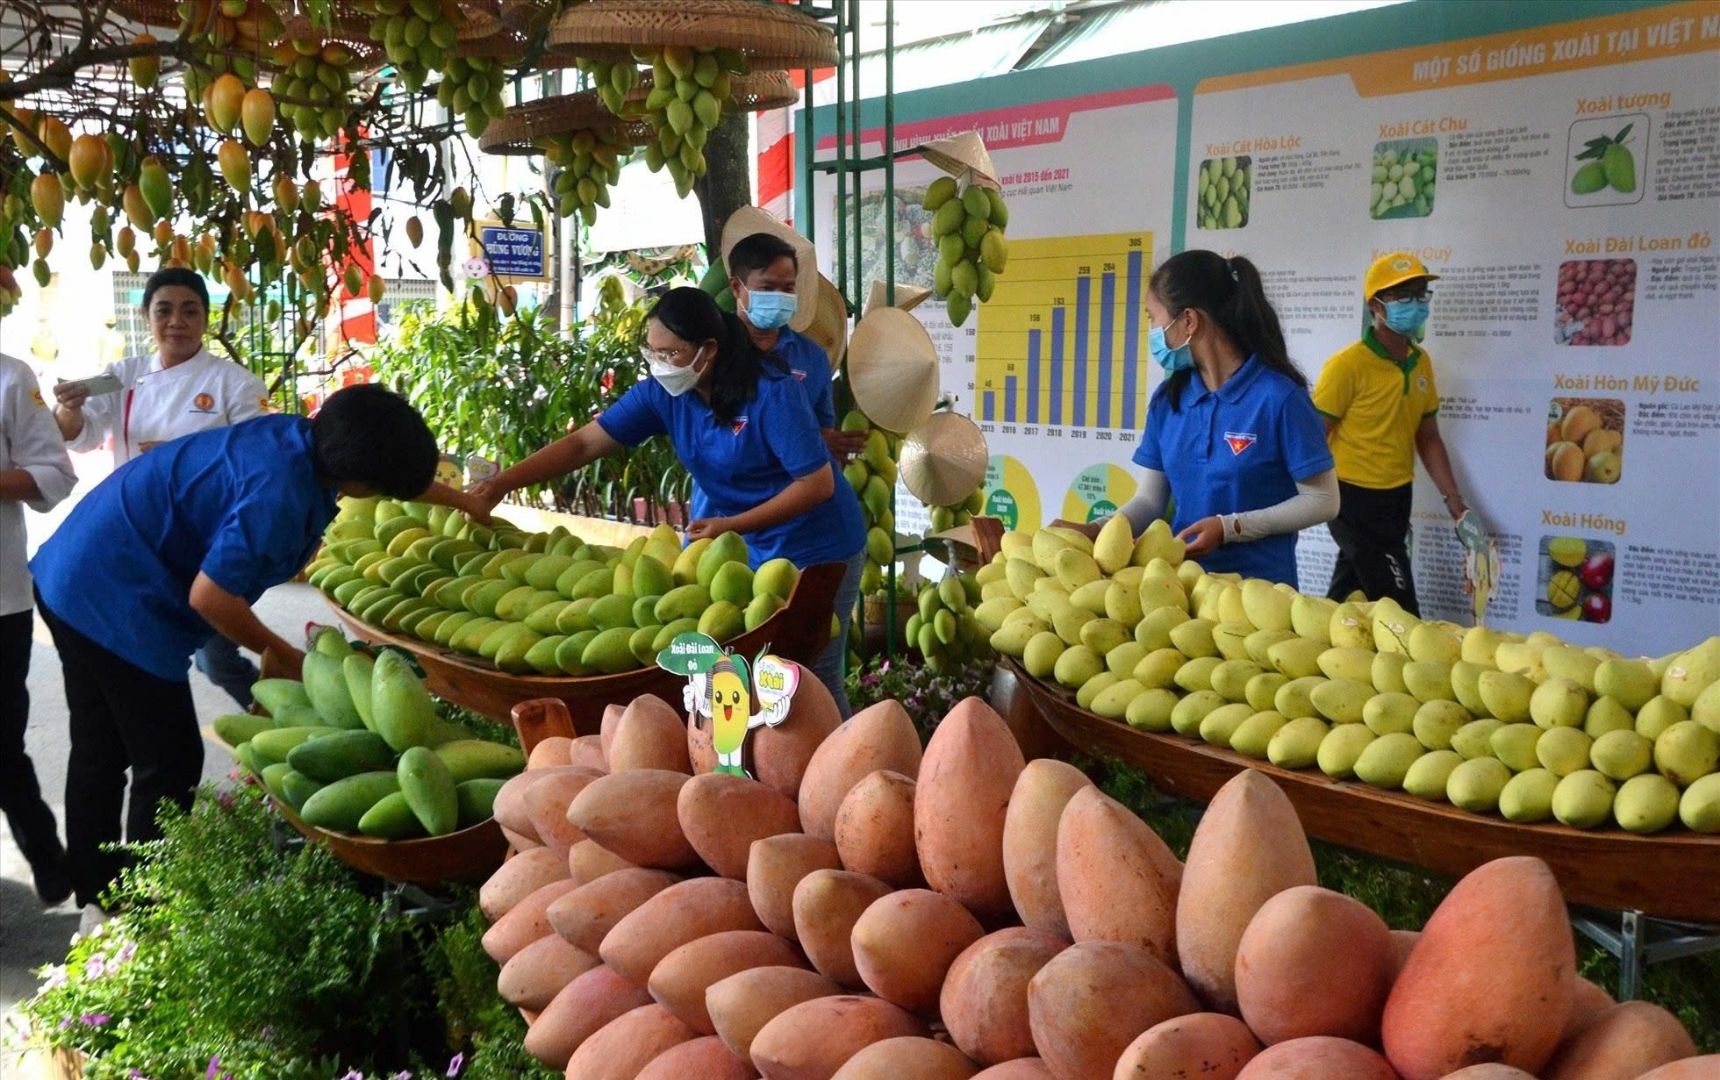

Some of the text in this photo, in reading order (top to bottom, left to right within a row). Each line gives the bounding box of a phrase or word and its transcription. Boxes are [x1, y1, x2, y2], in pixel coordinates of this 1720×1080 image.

[1412, 56, 1451, 82] MỘT
[1456, 45, 1481, 75] SỐ
[1486, 39, 1545, 70] GIỐNG
[1552, 33, 1600, 61] XOÀI
[1607, 27, 1638, 54] TẠI
[1646, 16, 1695, 47] VIỆT
[1576, 91, 1671, 114] Xoài tượng
[986, 122, 1009, 142] XOÀI
[1010, 118, 1032, 140] VIỆT
[1035, 117, 1060, 135] NAM
[1379, 116, 1468, 138] Xoài Cát Chu
[1206, 134, 1302, 156] Xoài Cát Hòa Lộc
[1024, 172, 1039, 183] 2015
[1054, 168, 1069, 180] 2021
[1565, 231, 1712, 254] Xoài Đài Loan đỏ
[1554, 374, 1700, 395] Xoài Hòn Mỹ Đức
[981, 423, 1135, 442] 2015 2016 2017 2018 2019 2020 2021
[1541, 510, 1626, 535] Xoài Hồng
[671, 642, 714, 654] Xoài Đài Loan
